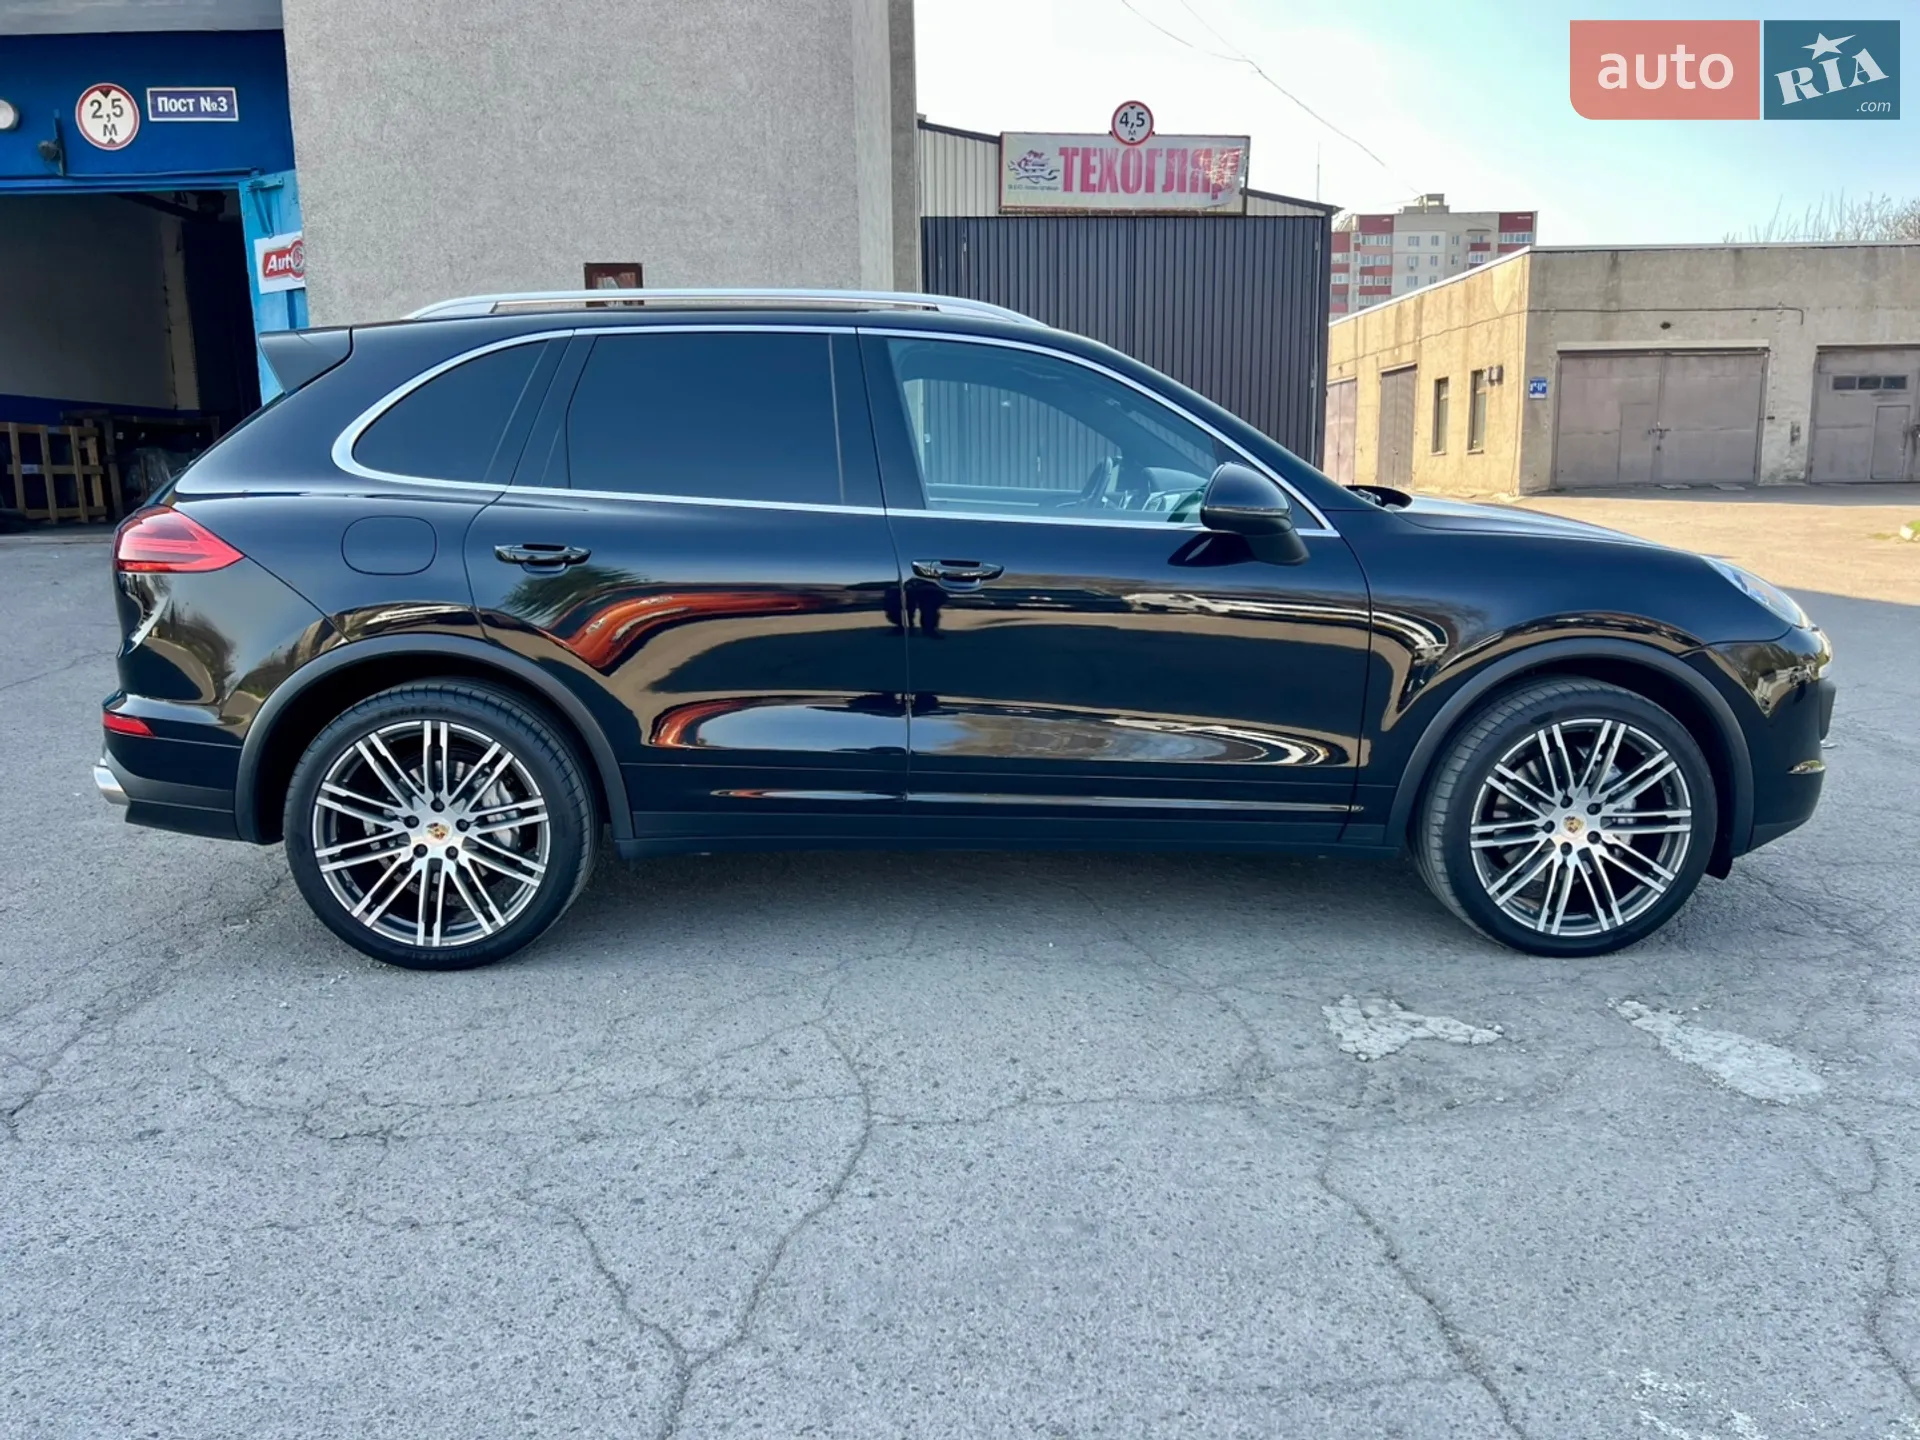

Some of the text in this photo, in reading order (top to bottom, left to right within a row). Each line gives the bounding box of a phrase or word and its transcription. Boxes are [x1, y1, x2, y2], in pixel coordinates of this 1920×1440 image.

[90, 98, 124, 123] 2,5
[157, 97, 228, 112] Пост №3
[1119, 111, 1146, 129] 4,5
